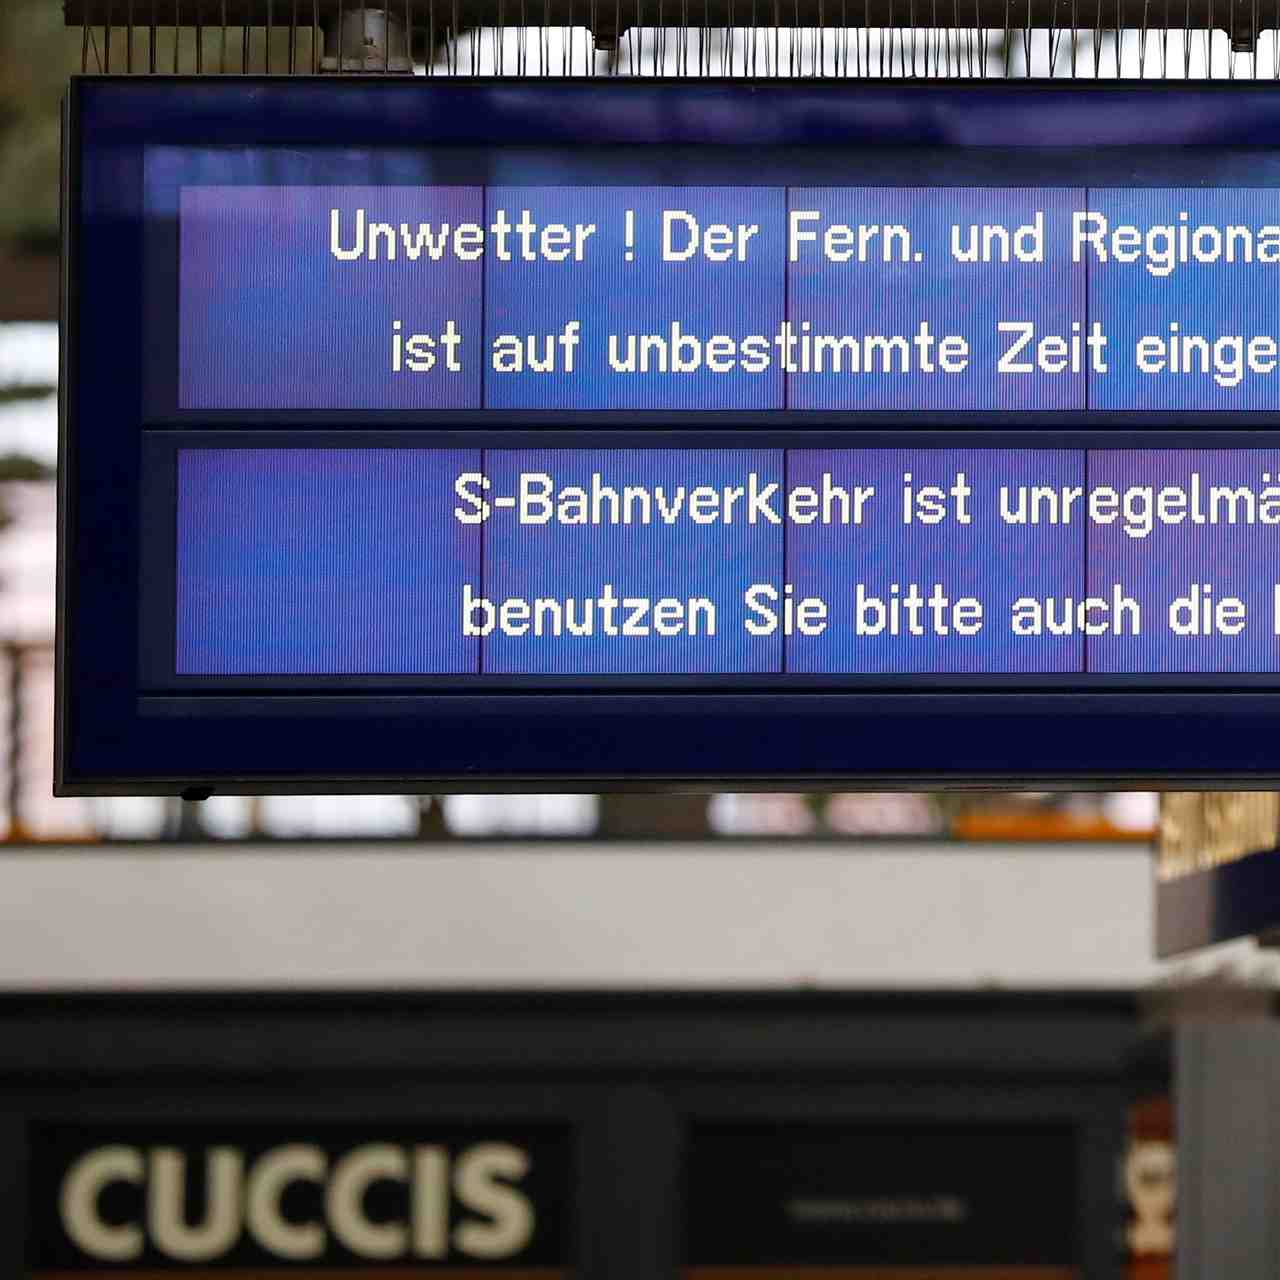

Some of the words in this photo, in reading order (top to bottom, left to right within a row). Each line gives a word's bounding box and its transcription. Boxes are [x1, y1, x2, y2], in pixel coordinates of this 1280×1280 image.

[330, 209, 596, 261] Unwetter
[625, 210, 634, 261] !
[662, 210, 759, 261] Der
[790, 210, 922, 262] Fern.
[951, 211, 1044, 262] und
[392, 320, 461, 372] ist
[493, 321, 580, 372] auf
[609, 321, 969, 373] unbestimmte
[997, 321, 1107, 373] Zeit
[454, 472, 875, 524] S-Bahnverkehr
[903, 473, 971, 524] ist
[463, 584, 716, 636] benutzen
[744, 584, 827, 636] Sie
[856, 583, 983, 635] bitte
[1011, 584, 1140, 635] auch
[1169, 583, 1246, 635] die
[61, 1142, 535, 1260] CUCCIS
